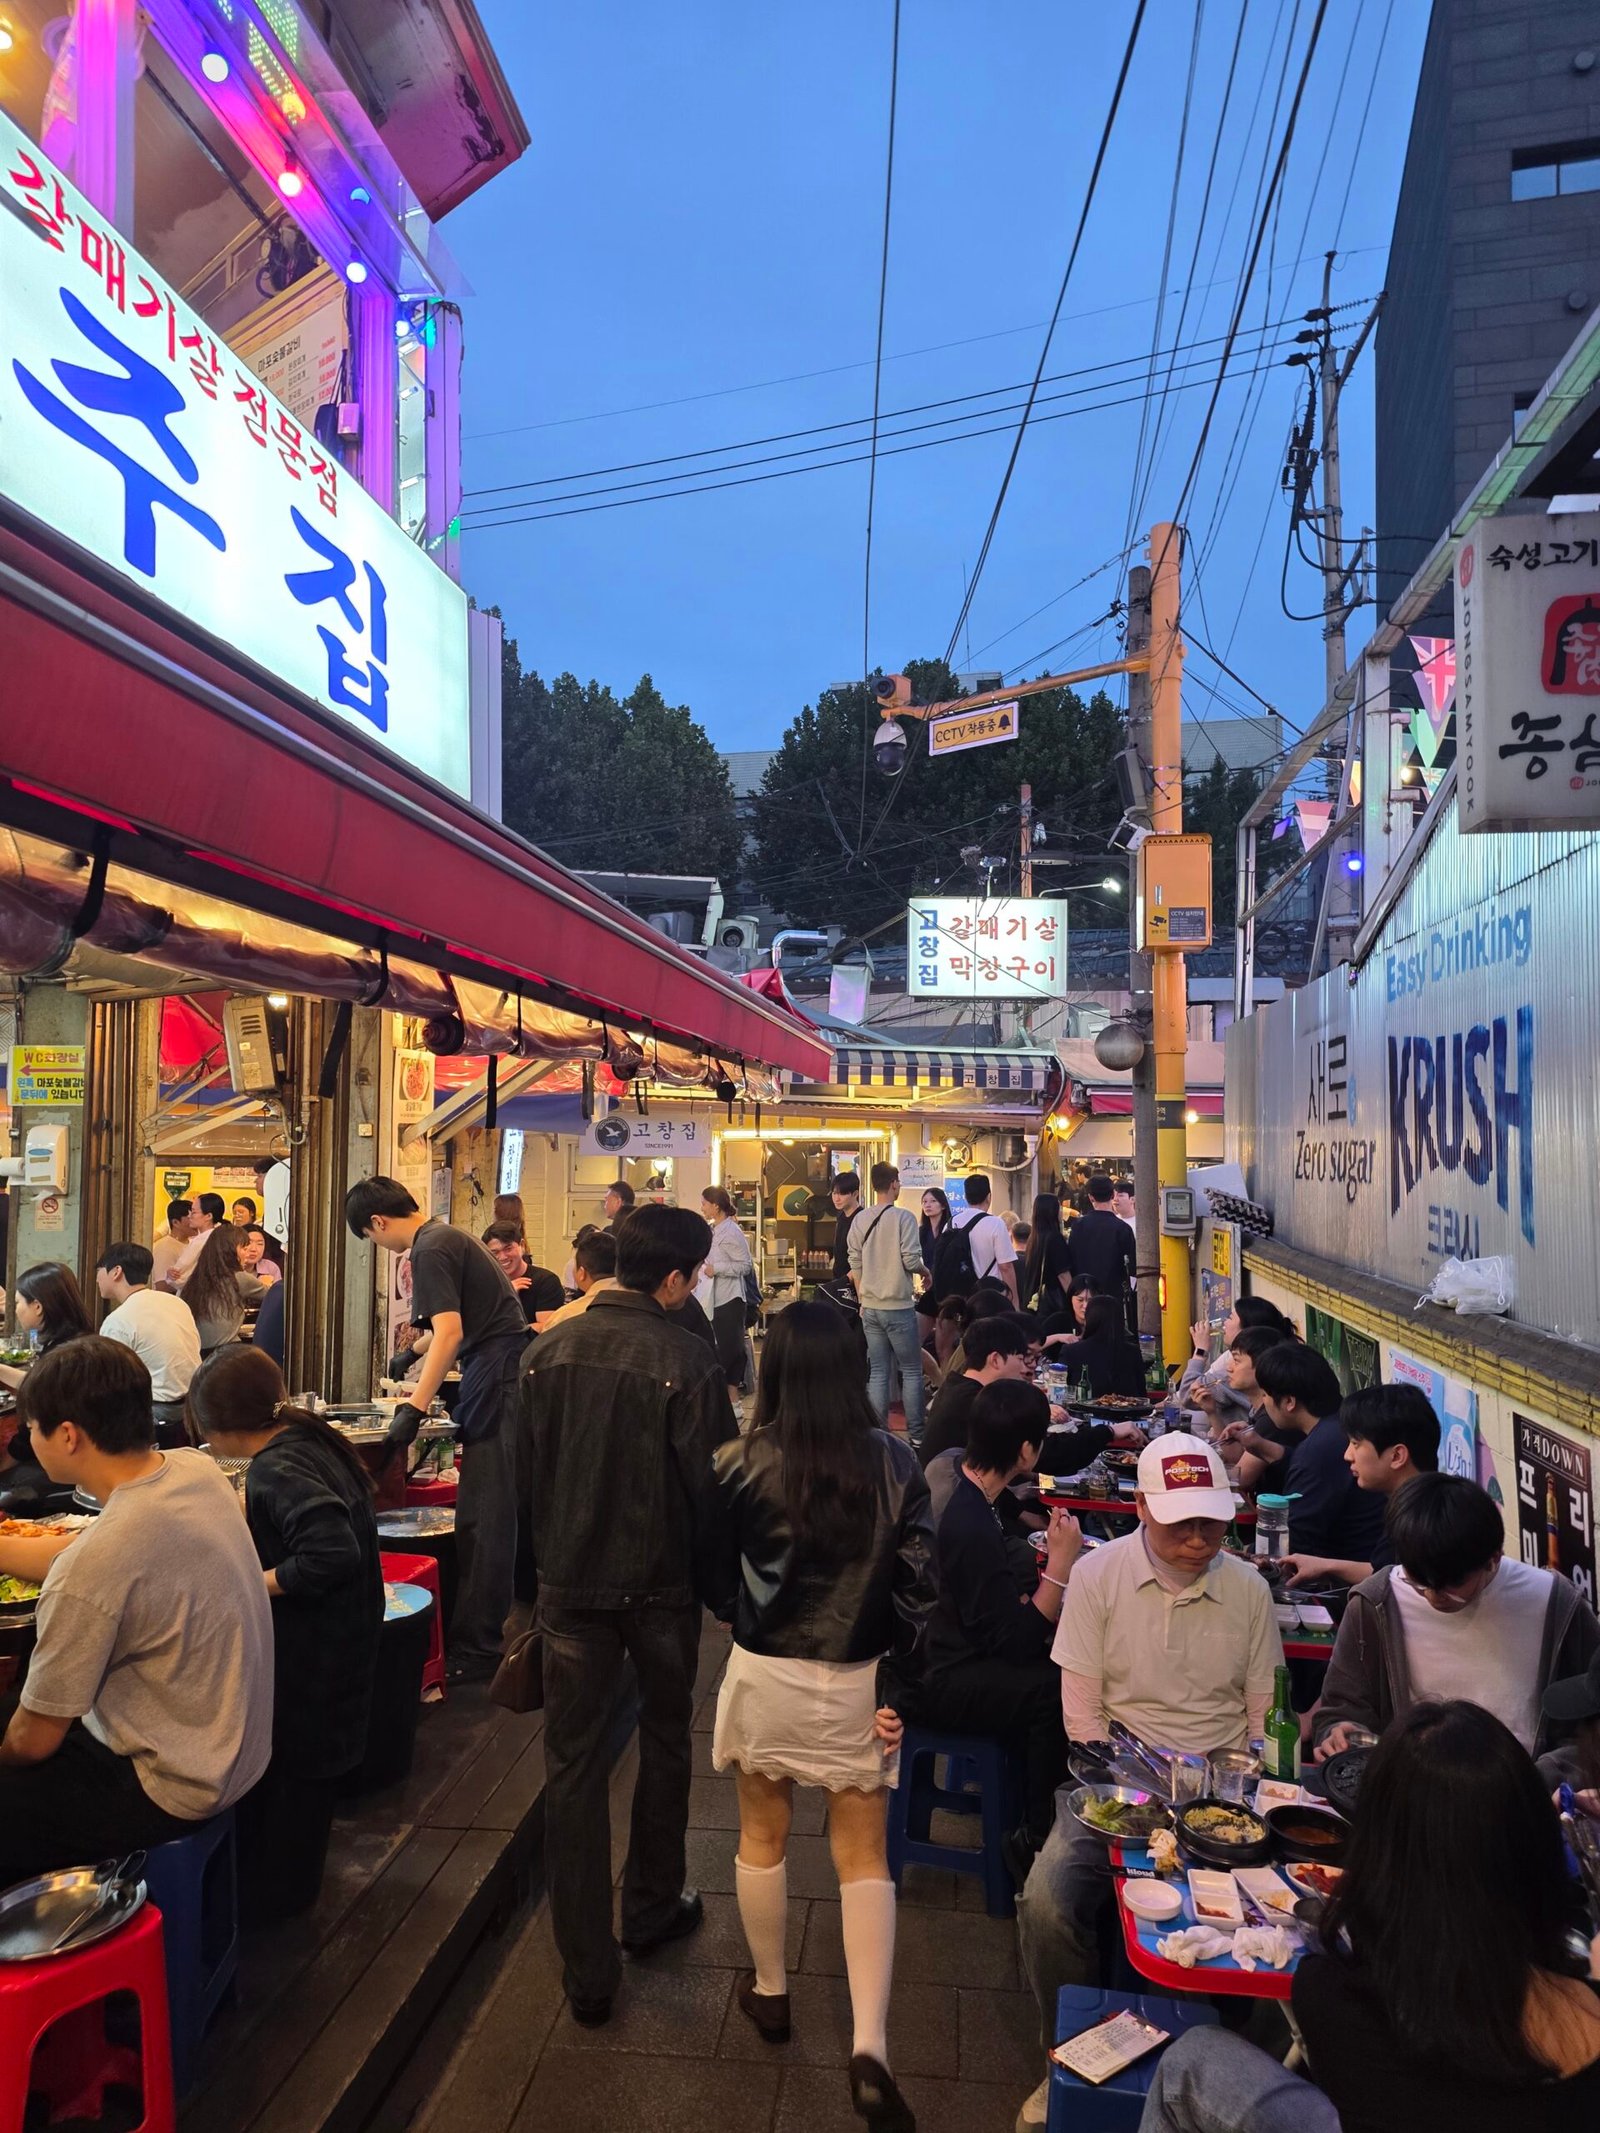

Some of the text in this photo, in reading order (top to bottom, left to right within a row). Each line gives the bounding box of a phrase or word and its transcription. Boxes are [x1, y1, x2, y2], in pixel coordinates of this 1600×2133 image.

[8, 148, 338, 518] 갈매기살 전문점
[1486, 538, 1599, 571] 숙성고기
[935, 718, 997, 743] CCTV 작동중
[1462, 596, 1475, 815] JONGSAMYOOK
[918, 909, 940, 986] 고창집
[949, 915, 1059, 941] 갈매기살
[1386, 903, 1532, 1003] Easy Drinking
[949, 956, 1055, 981] 막창구이
[965, 1073, 1021, 1086] 고창집
[1307, 1034, 1347, 1127] 새로
[632, 1121, 696, 1141] 고창집
[1387, 1003, 1535, 1249] KRUSH
[1295, 1130, 1377, 1203] Zero sugar
[1126, 1867, 1156, 1878] Kloud
